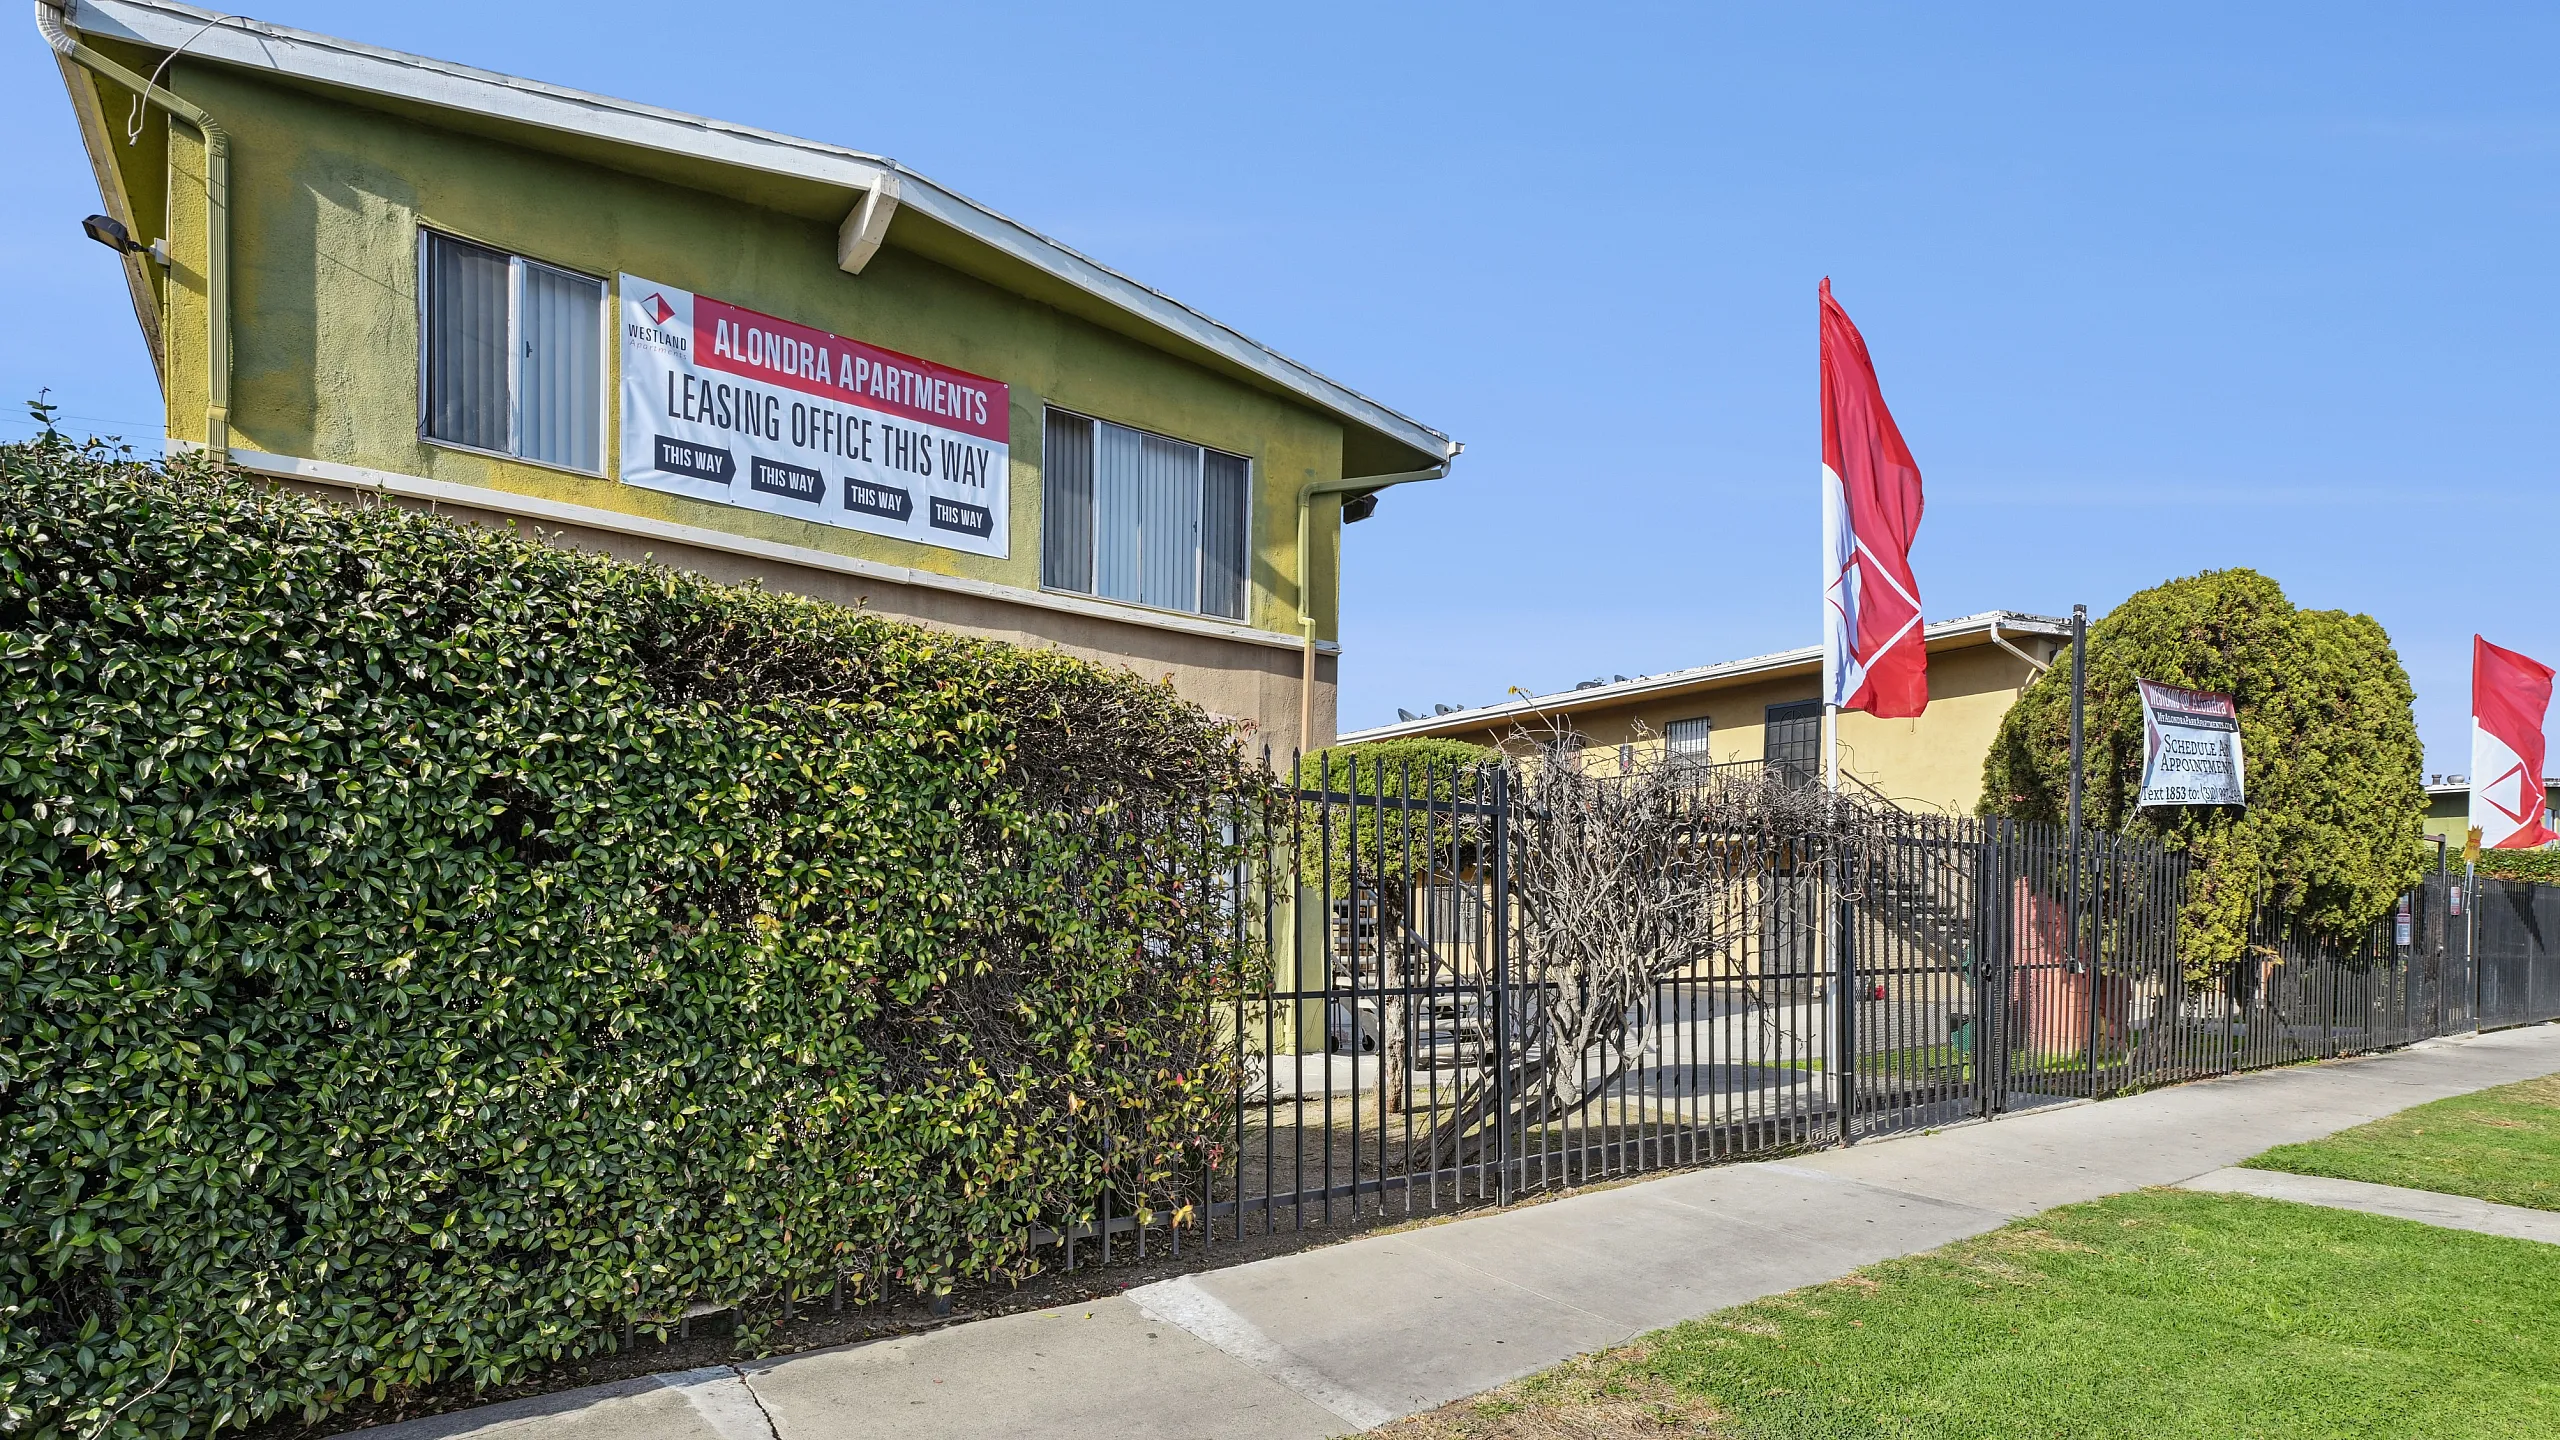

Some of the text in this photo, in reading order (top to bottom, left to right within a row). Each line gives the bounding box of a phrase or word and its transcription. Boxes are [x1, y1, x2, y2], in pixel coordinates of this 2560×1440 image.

[628, 323, 687, 351] WESTLAND
[629, 339, 687, 360] Apartments
[714, 318, 988, 426] ALONDRA APARTMENTS
[667, 370, 989, 489] LEASING OFFICE THIS WAY
[662, 443, 723, 474] THIS WAY
[759, 464, 815, 494] THIS WAY
[851, 485, 902, 512] THIS WAY
[935, 503, 983, 529] THIS WAY
[2148, 684, 2180, 709] WESTLAND
[2191, 692, 2228, 715] Alondra
[2164, 733, 2217, 756] SCHEDULE
[2160, 752, 2234, 775] APPOINTMENT
[2142, 785, 2164, 801] Text
[2165, 786, 2186, 800] 1853
[2188, 787, 2199, 800] to:
